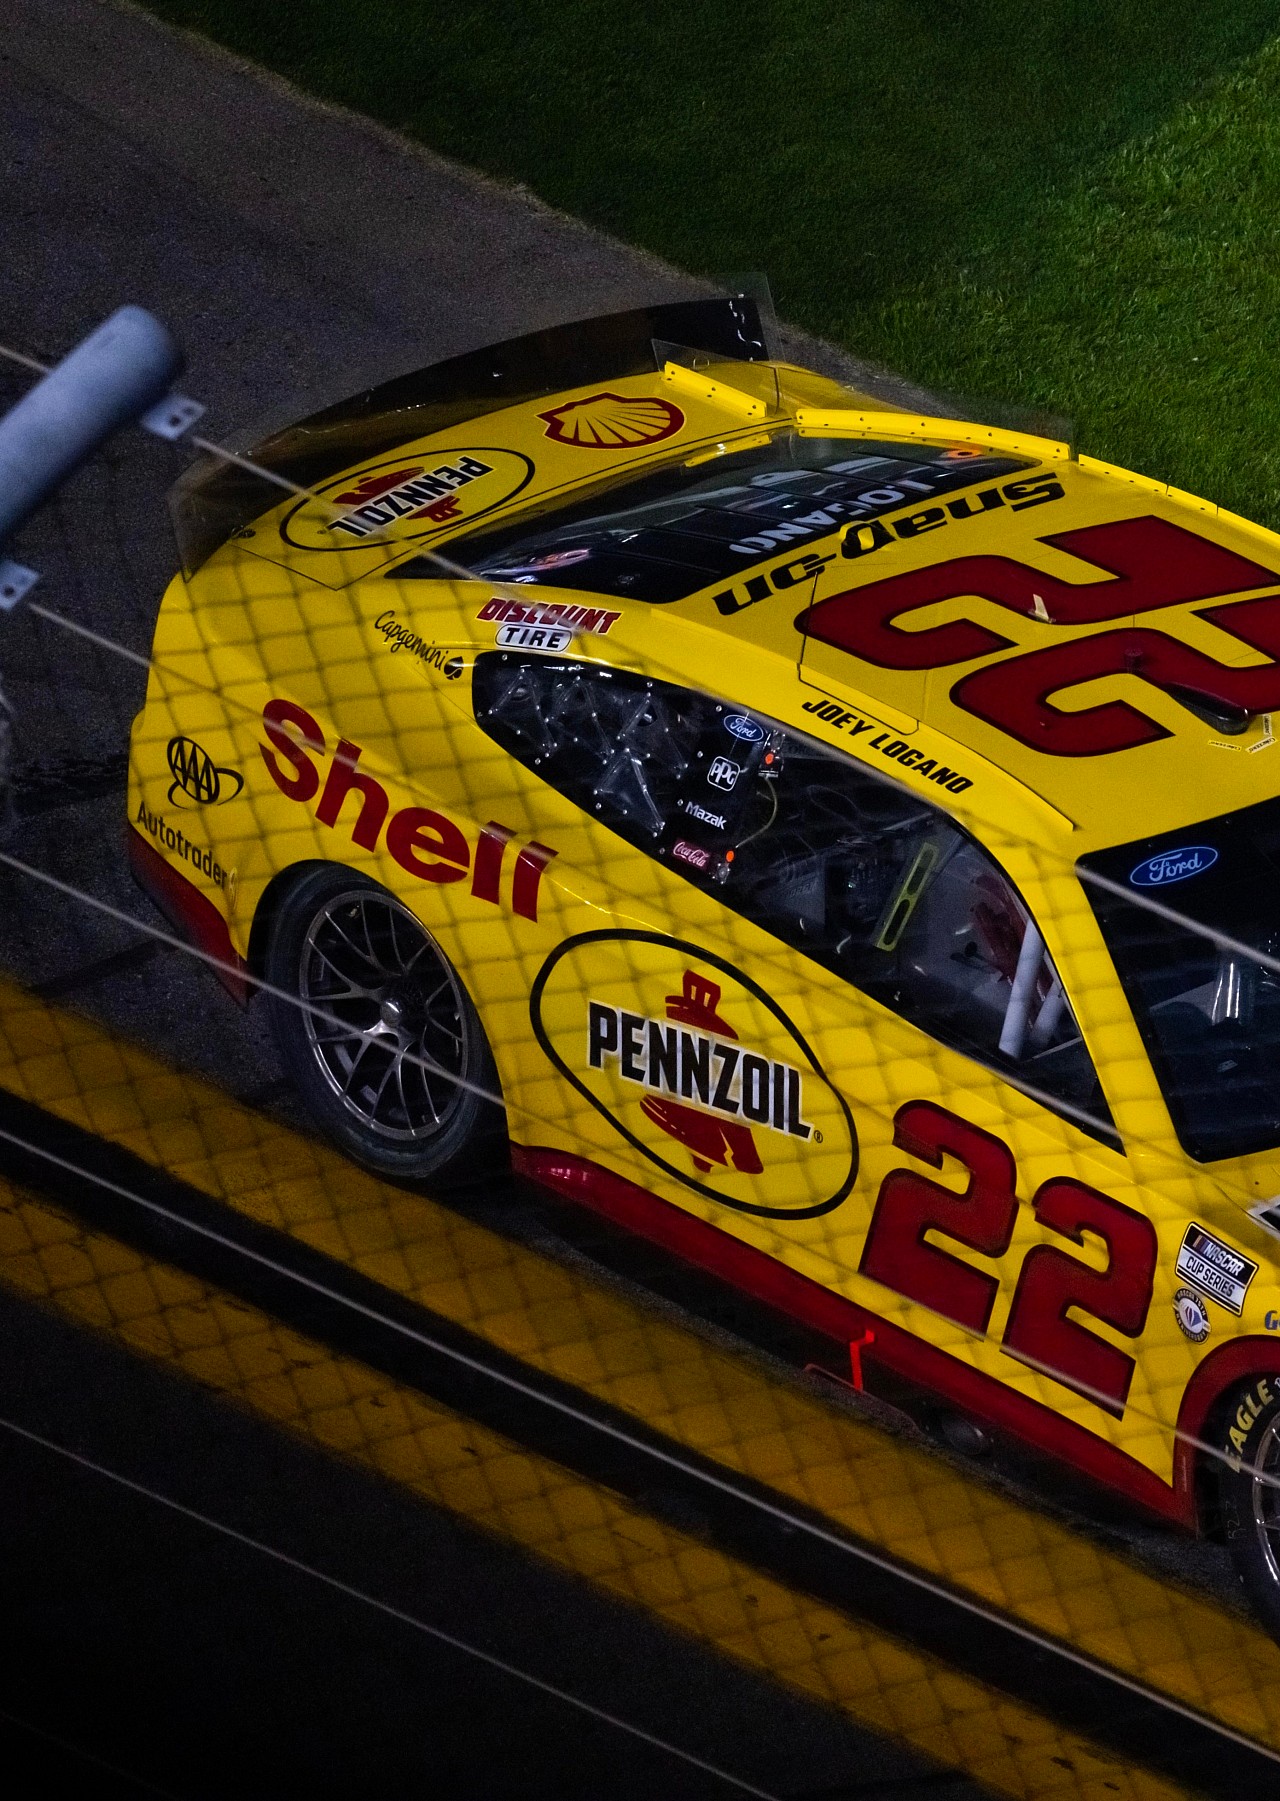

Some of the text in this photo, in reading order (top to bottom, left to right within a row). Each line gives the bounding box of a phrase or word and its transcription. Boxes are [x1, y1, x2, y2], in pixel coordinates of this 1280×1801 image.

[327, 456, 494, 538] PENNZOIL
[374, 610, 449, 671] Capgemini
[477, 598, 621, 634] DISCOUNT
[505, 627, 566, 649] TIRE
[728, 716, 759, 739] Ford
[802, 700, 974, 794] JOEY LOGANO
[169, 737, 219, 803] AAA
[258, 698, 559, 923] Shell
[685, 801, 727, 830] Mazak
[137, 801, 228, 890] Autotrader
[1146, 849, 1205, 884] Ford
[588, 1000, 815, 1141] PENNZOIL
[858, 1100, 1158, 1421] 22
[1186, 1256, 1236, 1297] CUP SERIES
[1203, 1240, 1246, 1277] NASCAR
